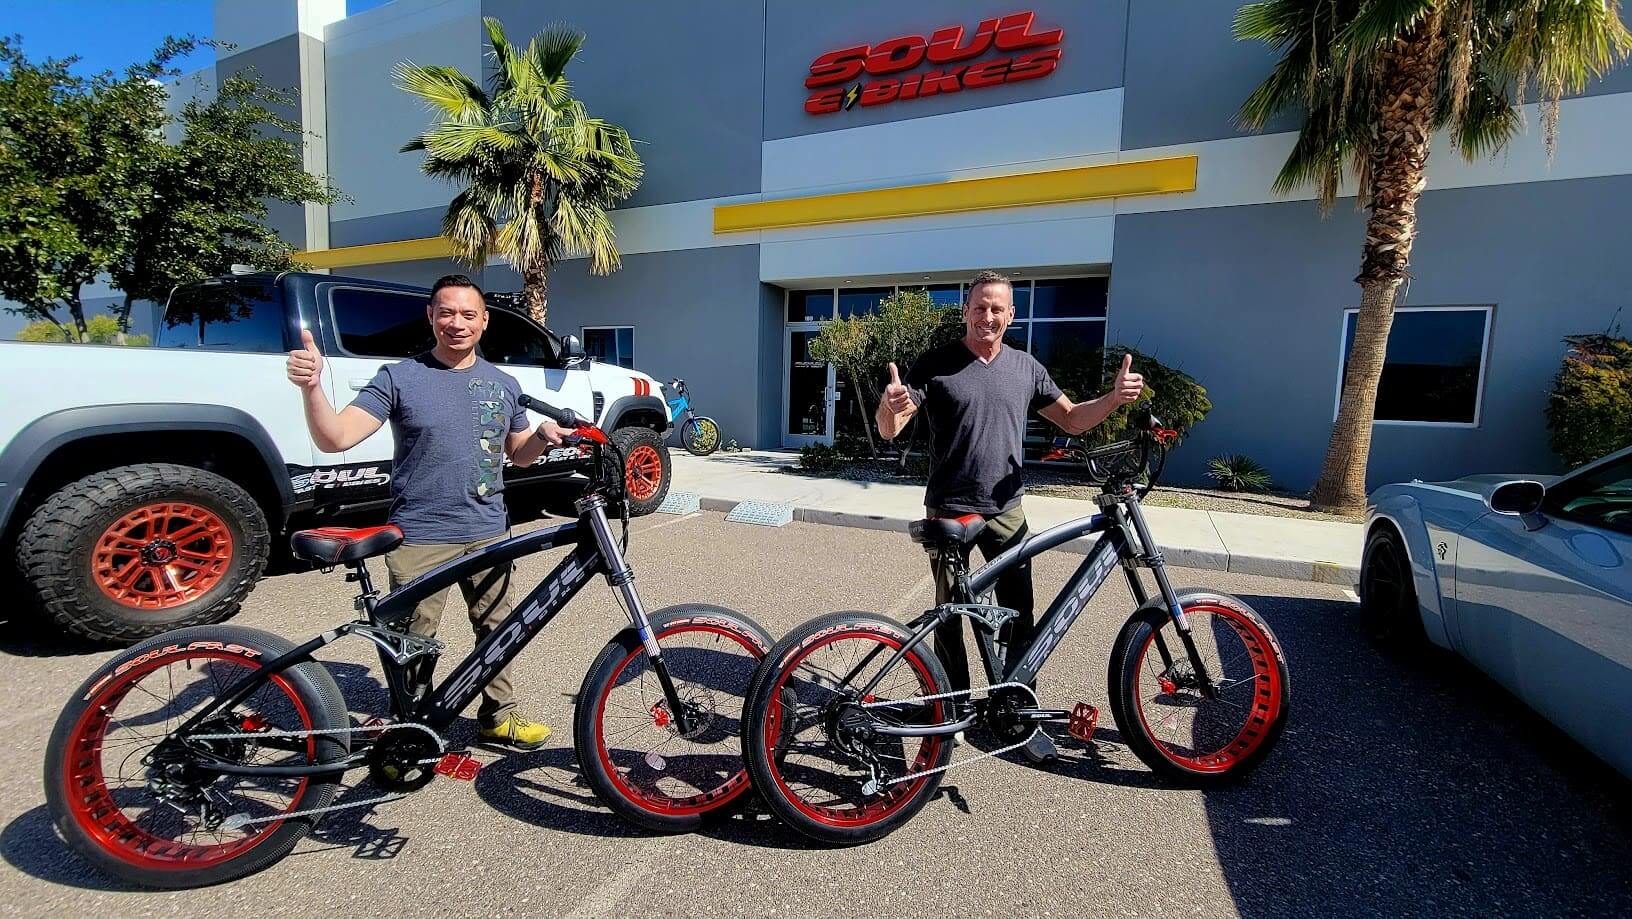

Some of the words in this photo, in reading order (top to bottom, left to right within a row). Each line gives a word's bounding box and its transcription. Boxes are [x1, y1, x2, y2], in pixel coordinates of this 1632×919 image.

[805, 11, 1064, 89] SOUL
[859, 48, 1062, 107] BIKES
[444, 551, 599, 709] SOUL
[1029, 540, 1120, 672] SOUL
[114, 644, 186, 677] SOUL
[187, 641, 262, 658] FAST
